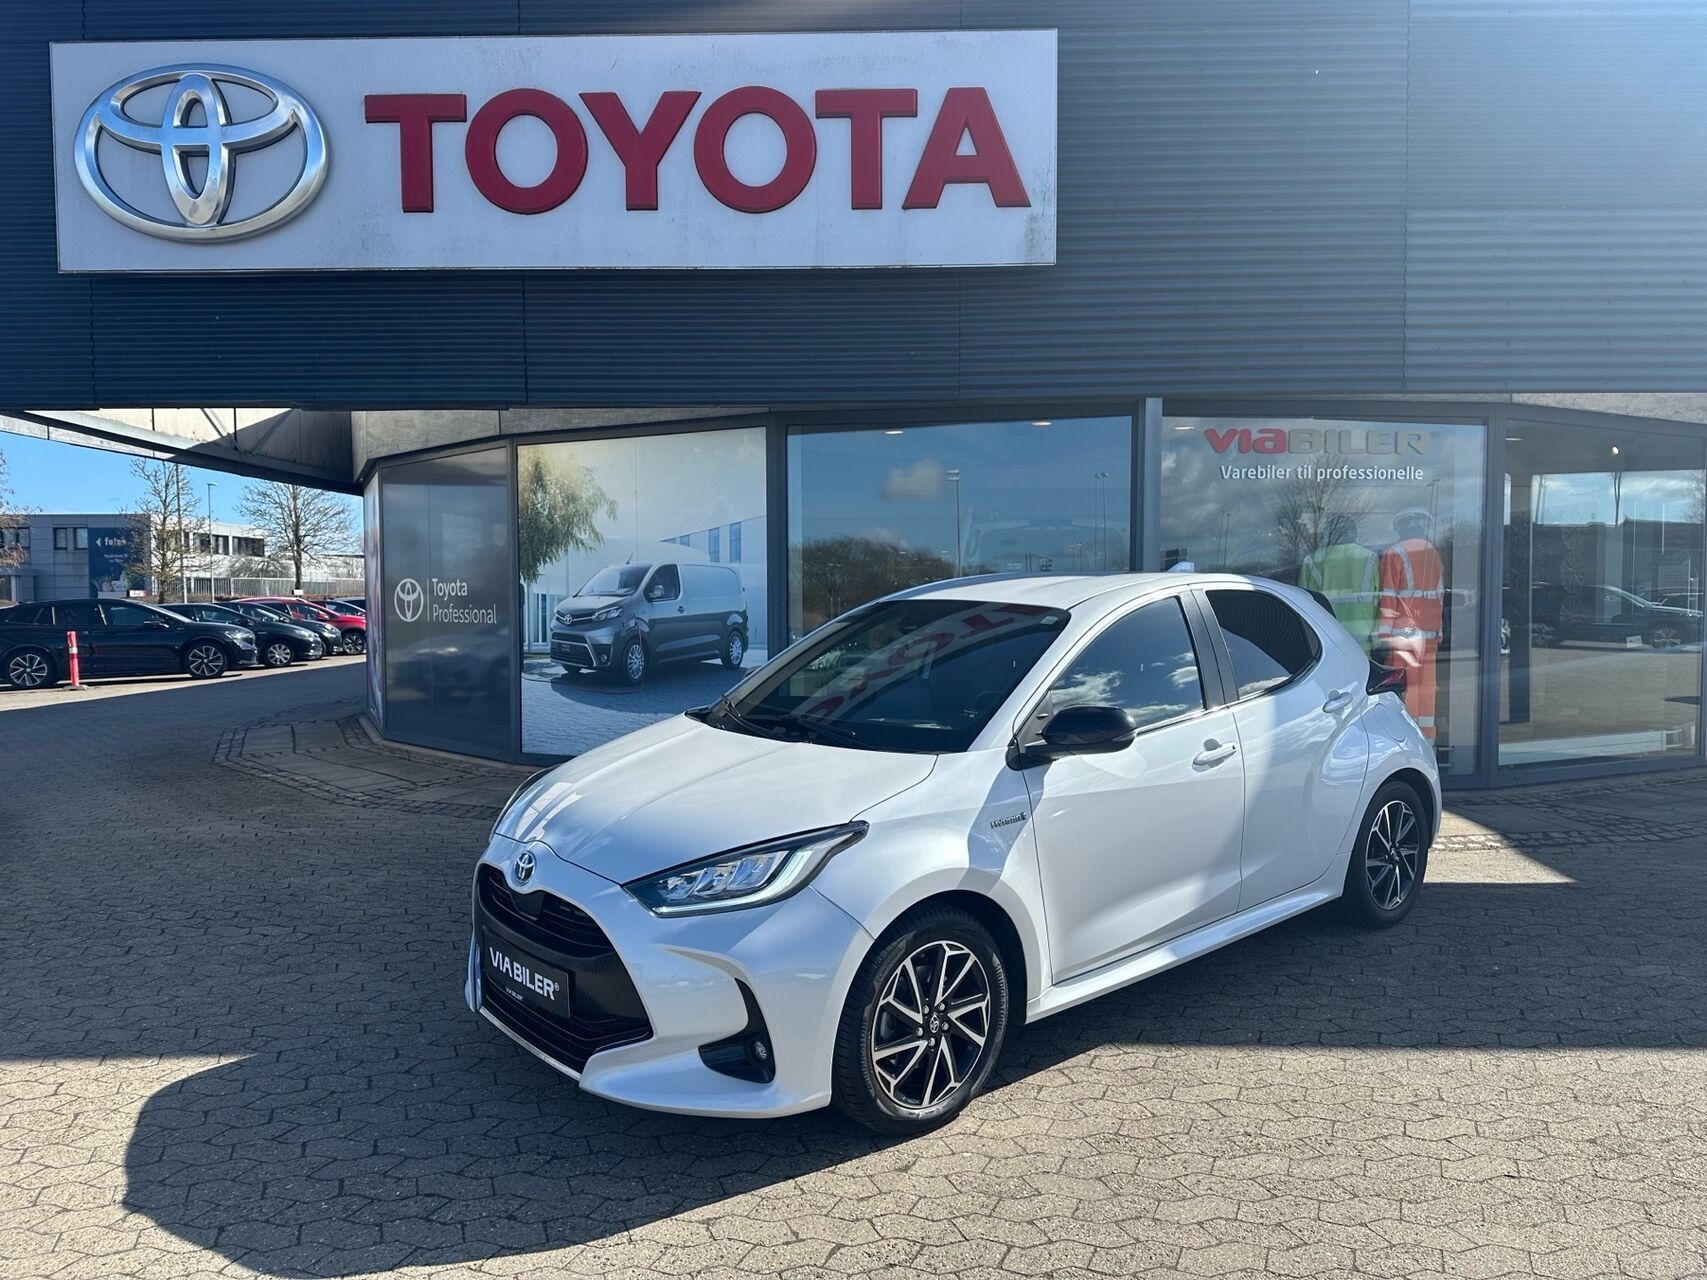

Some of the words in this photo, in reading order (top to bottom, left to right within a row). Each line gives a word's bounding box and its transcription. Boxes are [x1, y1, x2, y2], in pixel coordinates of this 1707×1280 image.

[364, 86, 1032, 214] TOYOTA
[1221, 464, 1291, 480] Varebiler
[1297, 465, 1312, 480] til
[1316, 464, 1424, 482] professionelle
[431, 577, 468, 601] Toyota
[433, 603, 497, 624] Professional
